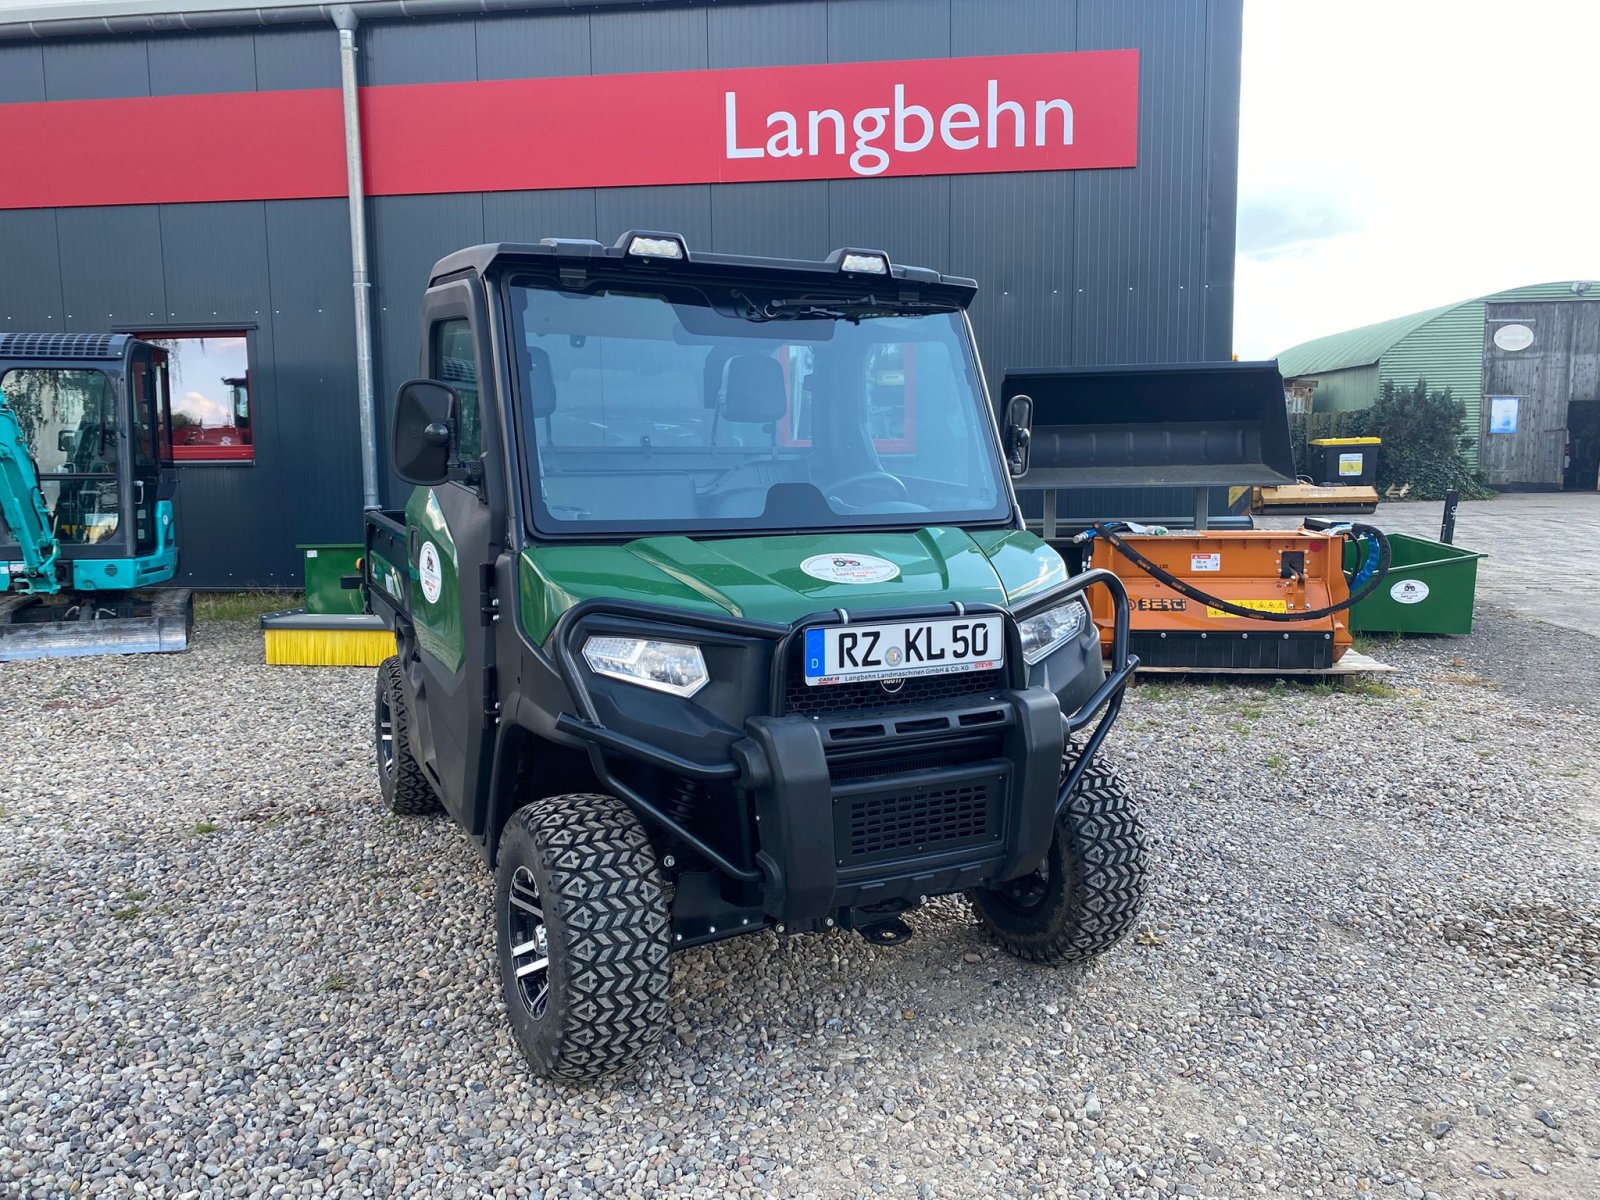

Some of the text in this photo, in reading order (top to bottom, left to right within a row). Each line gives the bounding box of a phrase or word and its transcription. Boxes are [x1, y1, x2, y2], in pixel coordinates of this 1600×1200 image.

[725, 79, 1074, 176] Langbehn
[838, 623, 988, 668] RZ KL 50
[811, 658, 819, 669] D
[845, 673, 876, 682] Langbehn
[877, 668, 925, 679] Landmaschinen
[926, 667, 945, 675] GmbH
